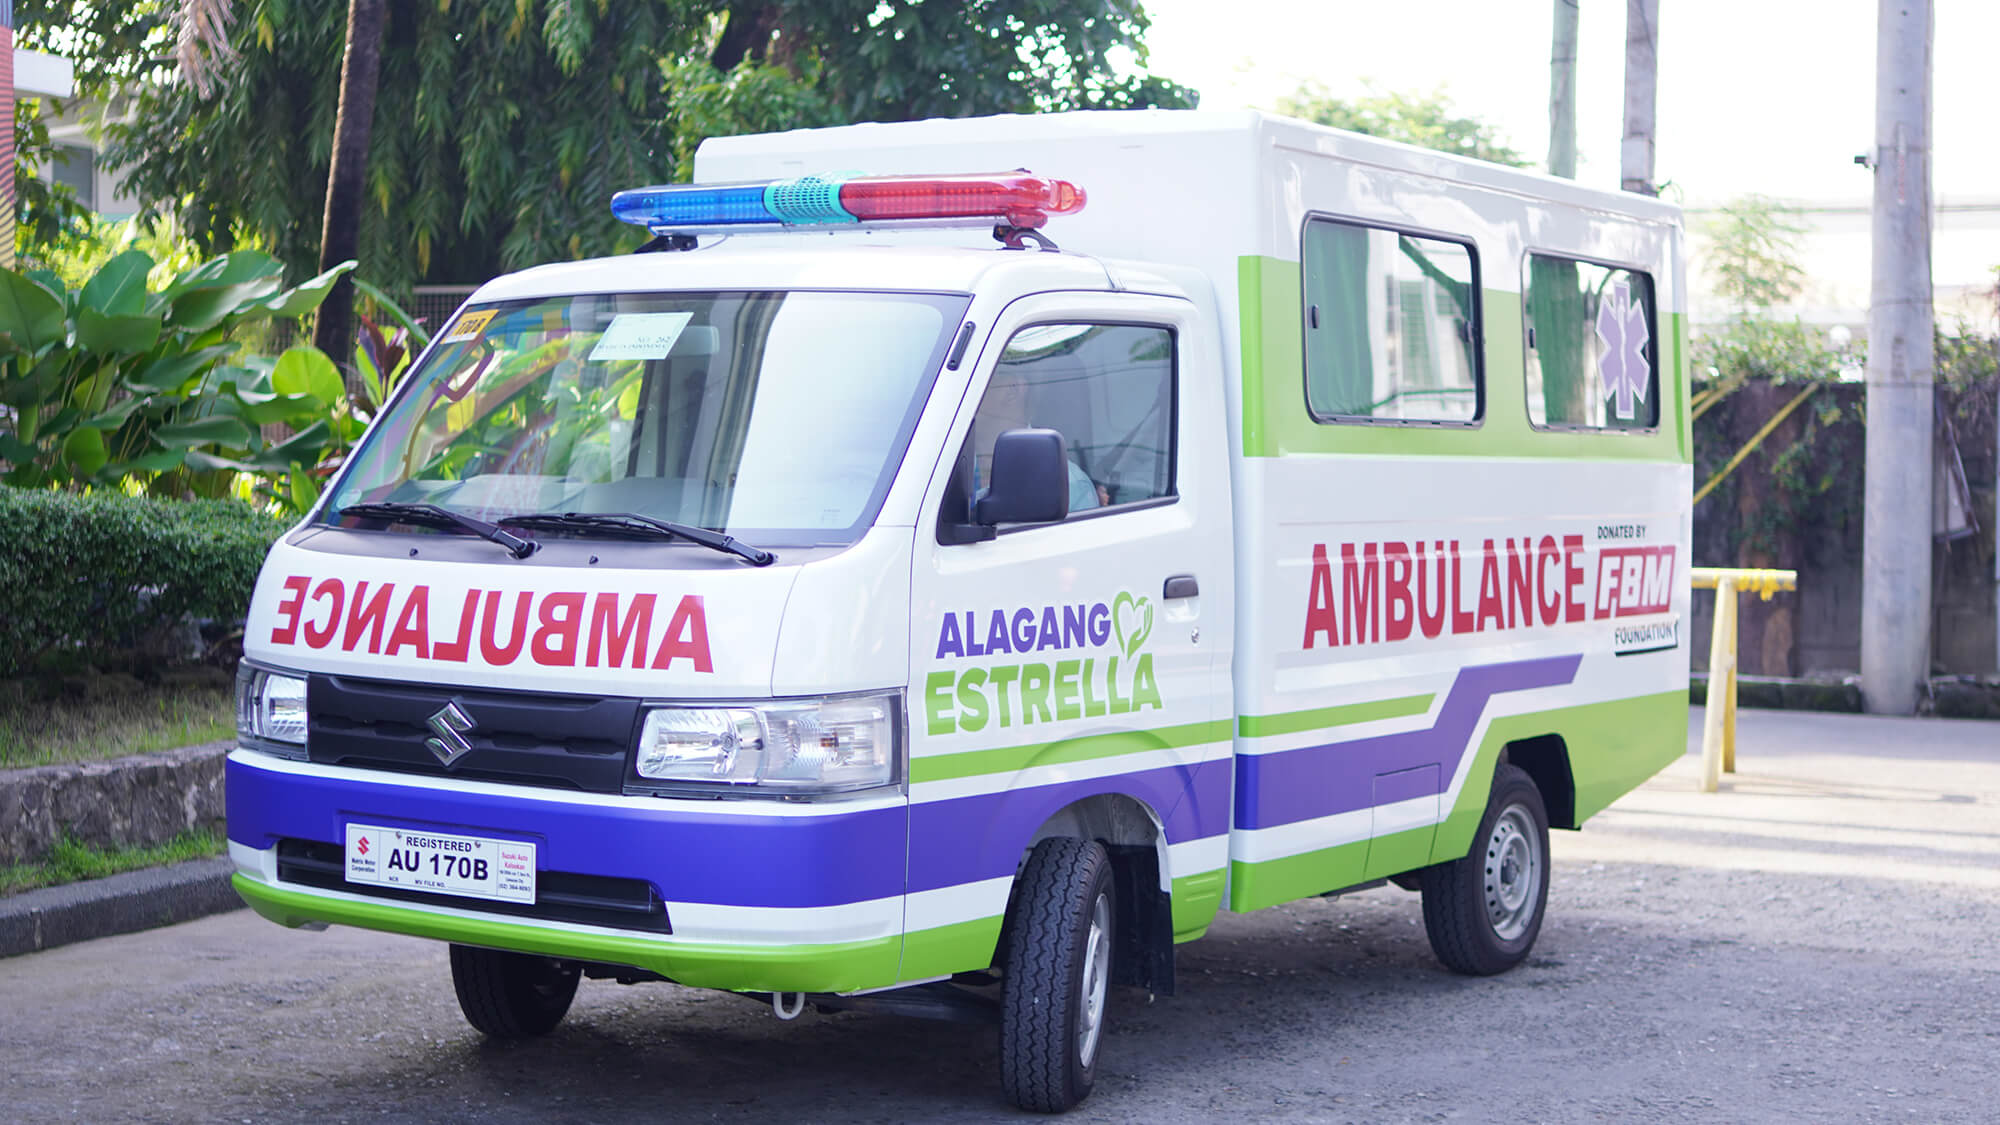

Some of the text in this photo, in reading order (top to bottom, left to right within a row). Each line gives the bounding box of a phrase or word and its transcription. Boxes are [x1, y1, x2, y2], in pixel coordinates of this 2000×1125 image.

[1597, 525, 1647, 539] DONATED BY
[1303, 535, 1585, 649] AMBULANCE
[1597, 551, 1674, 613] FBM
[936, 603, 1111, 659] ALAGANG
[1614, 622, 1673, 646] FOUNDATION
[925, 653, 1162, 736] ESTRELLA
[388, 848, 488, 881] AU 170B
[406, 836, 472, 852] REGISTERED
